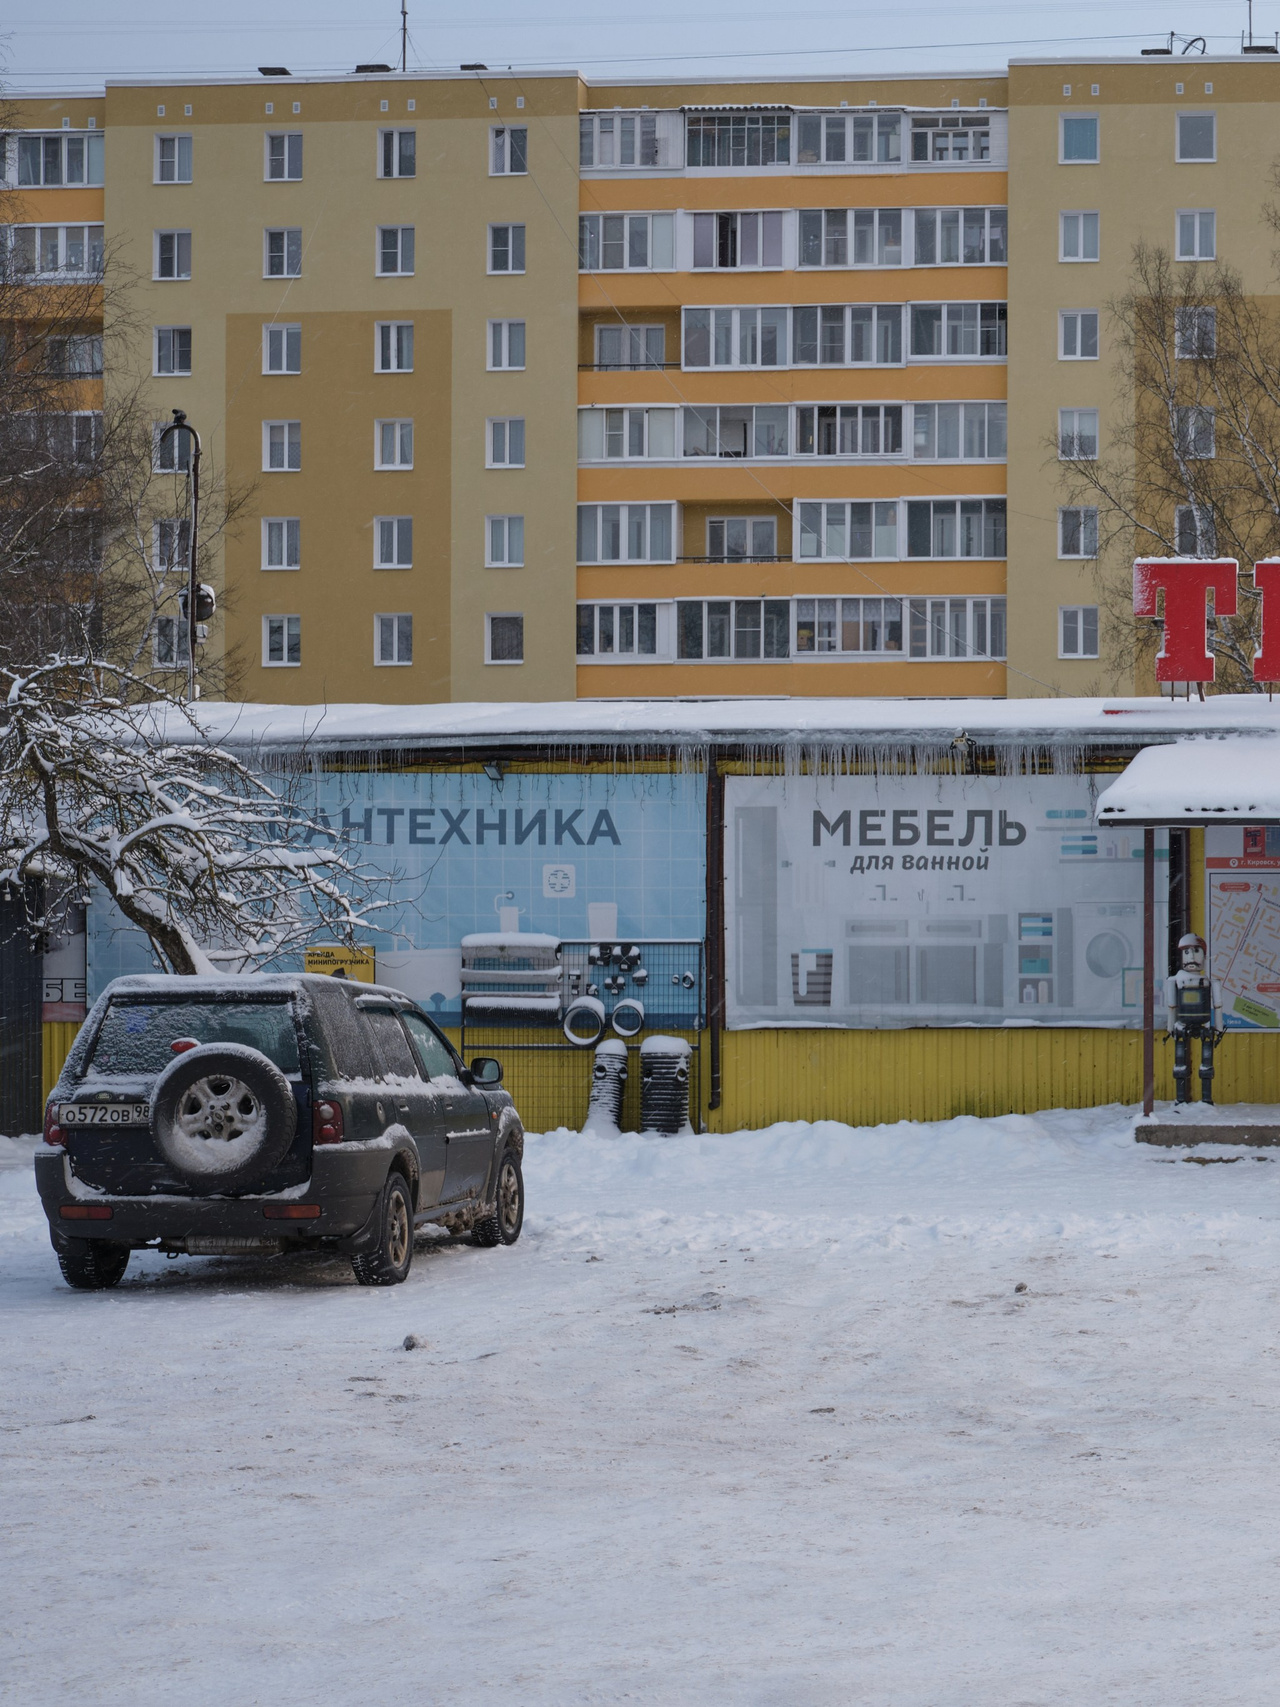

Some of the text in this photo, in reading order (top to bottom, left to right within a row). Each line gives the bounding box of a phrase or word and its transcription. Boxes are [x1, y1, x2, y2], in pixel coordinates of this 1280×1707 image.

[812, 809, 1027, 847] МЕБЕЛЬ
[850, 847, 989, 875] для ванной
